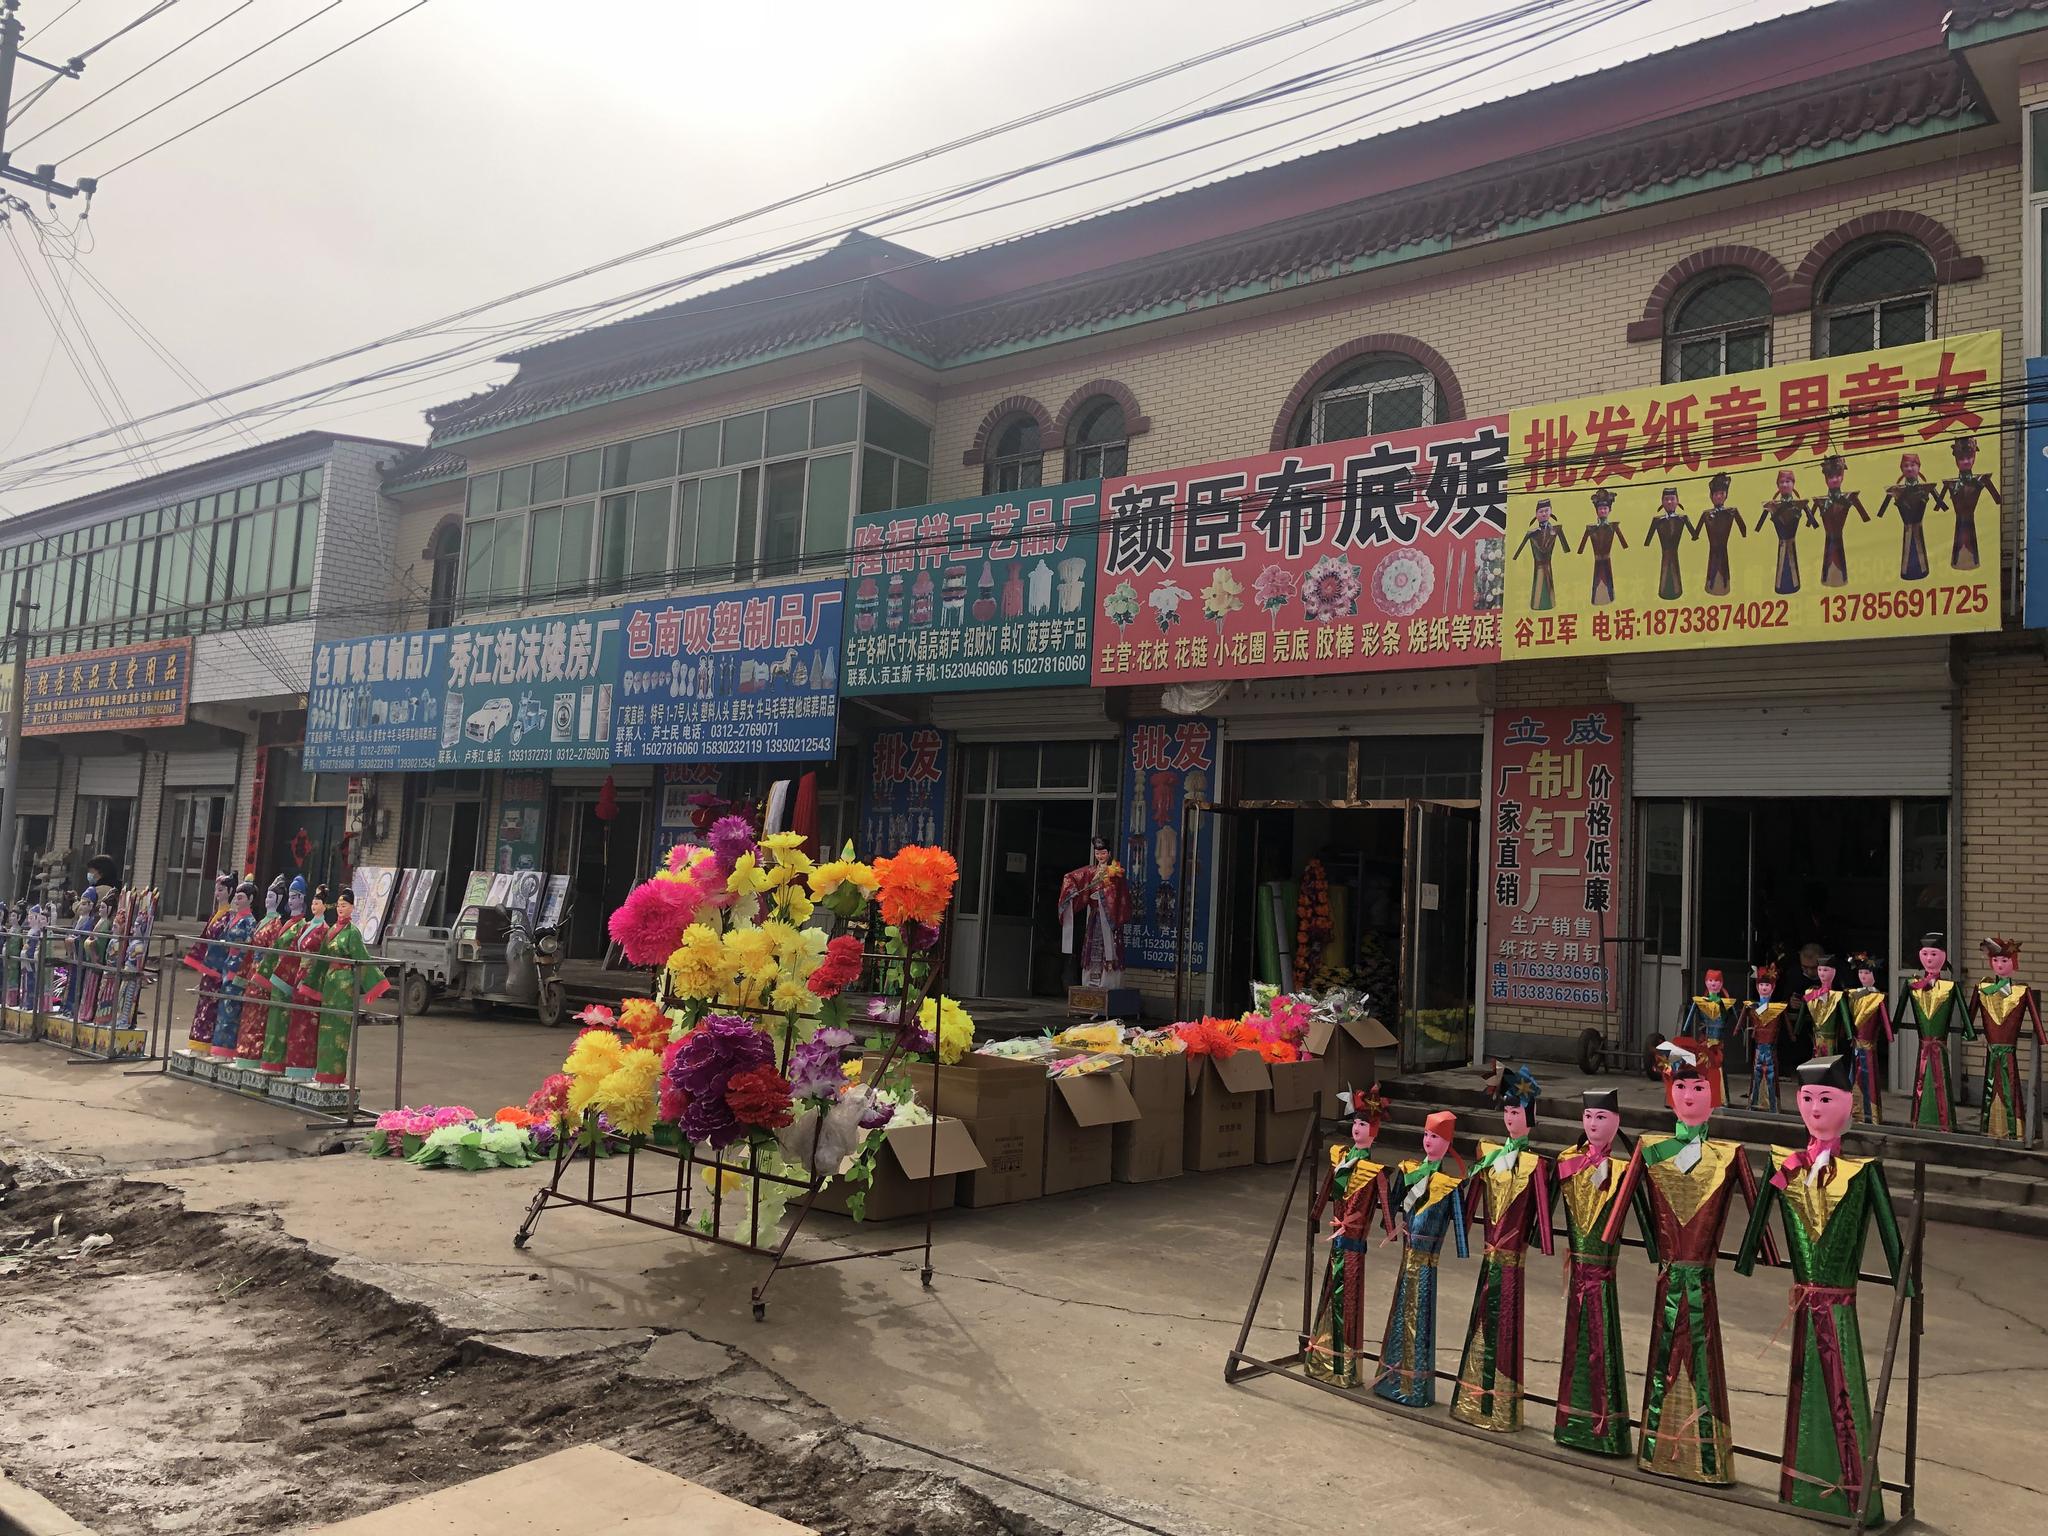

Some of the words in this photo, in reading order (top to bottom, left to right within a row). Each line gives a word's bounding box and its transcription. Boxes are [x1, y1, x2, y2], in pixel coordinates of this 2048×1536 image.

[1523, 352, 1988, 491] 批发纸童男童女
[852, 494, 1096, 578] 隆福祥工艺品厂
[626, 590, 842, 660] 色南吸塑制品厂
[1515, 613, 1578, 648] 谷卫军
[1820, 583, 1988, 625] 13785691725
[447, 618, 621, 689] 秀江泡沫楼房厂
[846, 628, 961, 666] 生产各种尺寸水晶亮葫芦
[963, 624, 998, 658] 招财灯
[1000, 622, 1024, 656] 串灯
[1026, 617, 1087, 654] 菠萝等产品
[1012, 654, 1086, 675] 15027816060
[1174, 635, 1209, 669] 花链
[1213, 631, 1267, 666] 小花圈
[1273, 627, 1310, 663] 亮底
[1315, 623, 1354, 660] 胶棒
[1361, 620, 1402, 657] 彩条
[731, 699, 755, 722] 童男女
[1504, 713, 1613, 745] 立威
[556, 747, 610, 761] 0312-2769076
[702, 739, 763, 755] 15830232119
[765, 737, 831, 754] 13930212543
[872, 729, 943, 784] 批发
[1132, 721, 1213, 772] 批发
[1495, 766, 1523, 907] 厂家直销
[1520, 748, 1587, 914] 制钉厂
[1584, 764, 1615, 912] 价格低廉
[1499, 940, 1601, 965] 纸花专用钉
[1511, 916, 1592, 938] 生产销售
